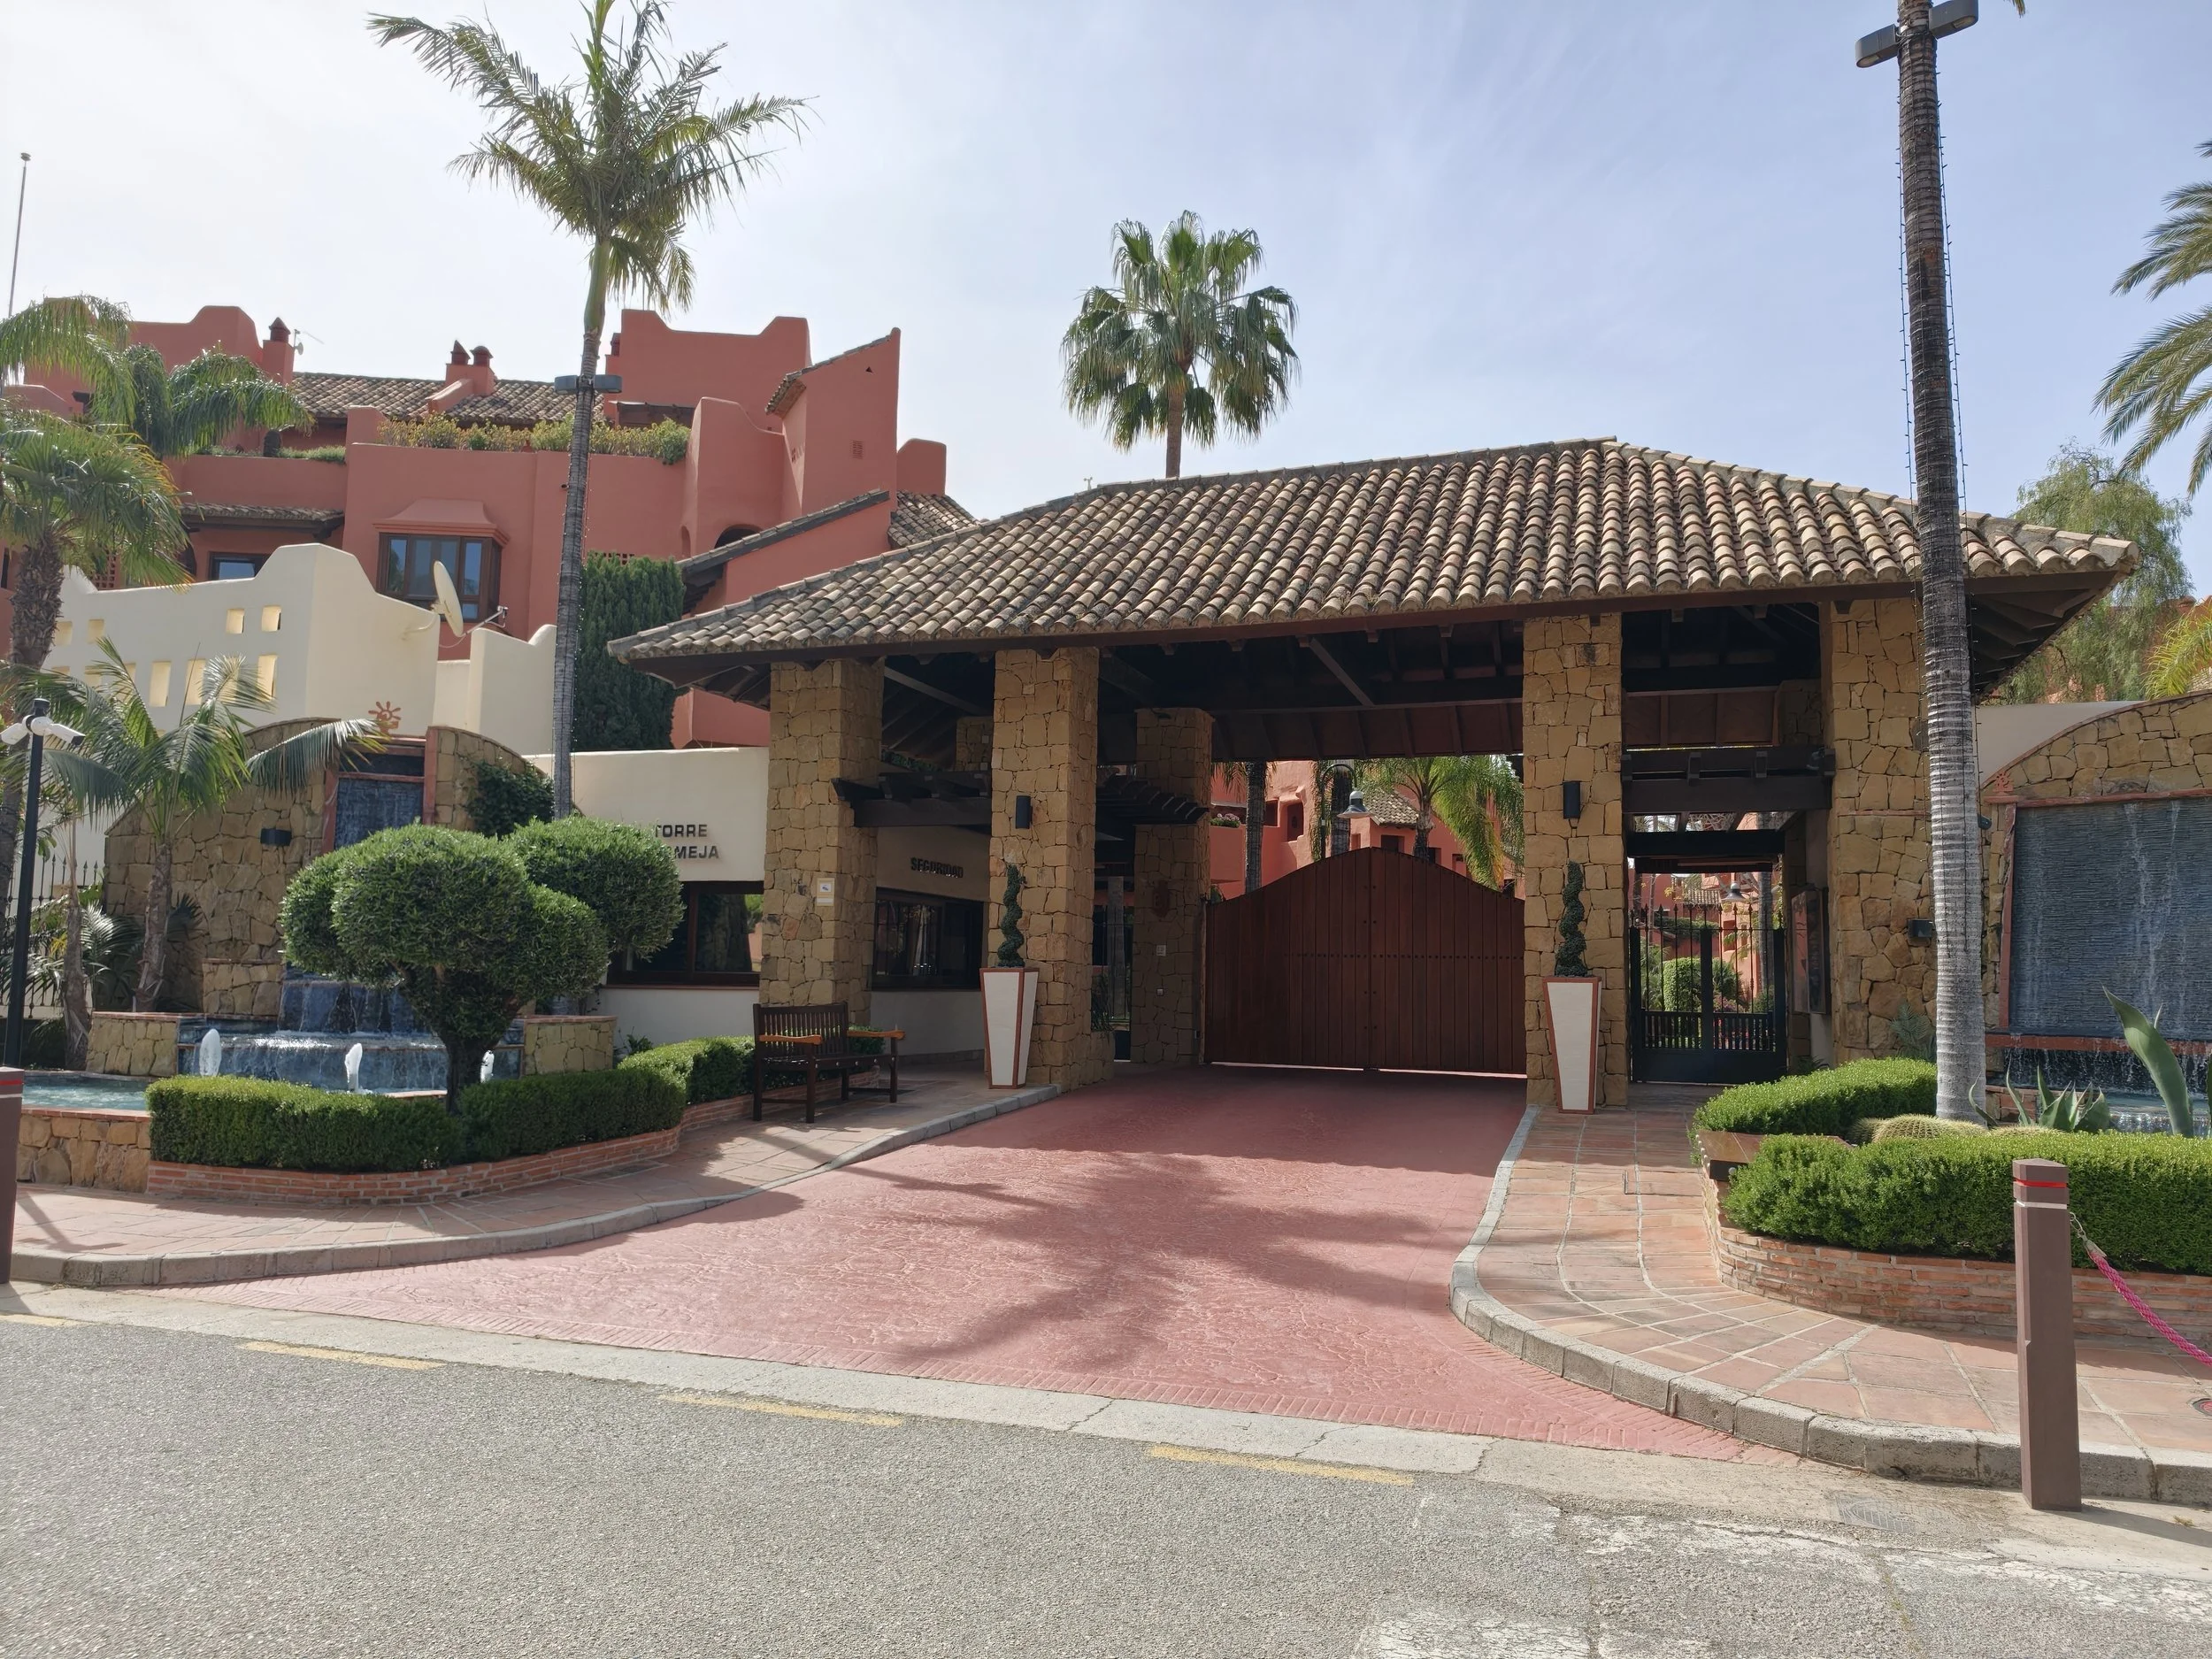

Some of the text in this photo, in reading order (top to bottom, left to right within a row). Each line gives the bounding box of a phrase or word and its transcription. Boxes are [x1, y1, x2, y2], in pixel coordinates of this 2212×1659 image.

[655, 824, 708, 838] TORRE
[672, 845, 719, 859] MEJA
[910, 856, 964, 878] SEGURIDAD
